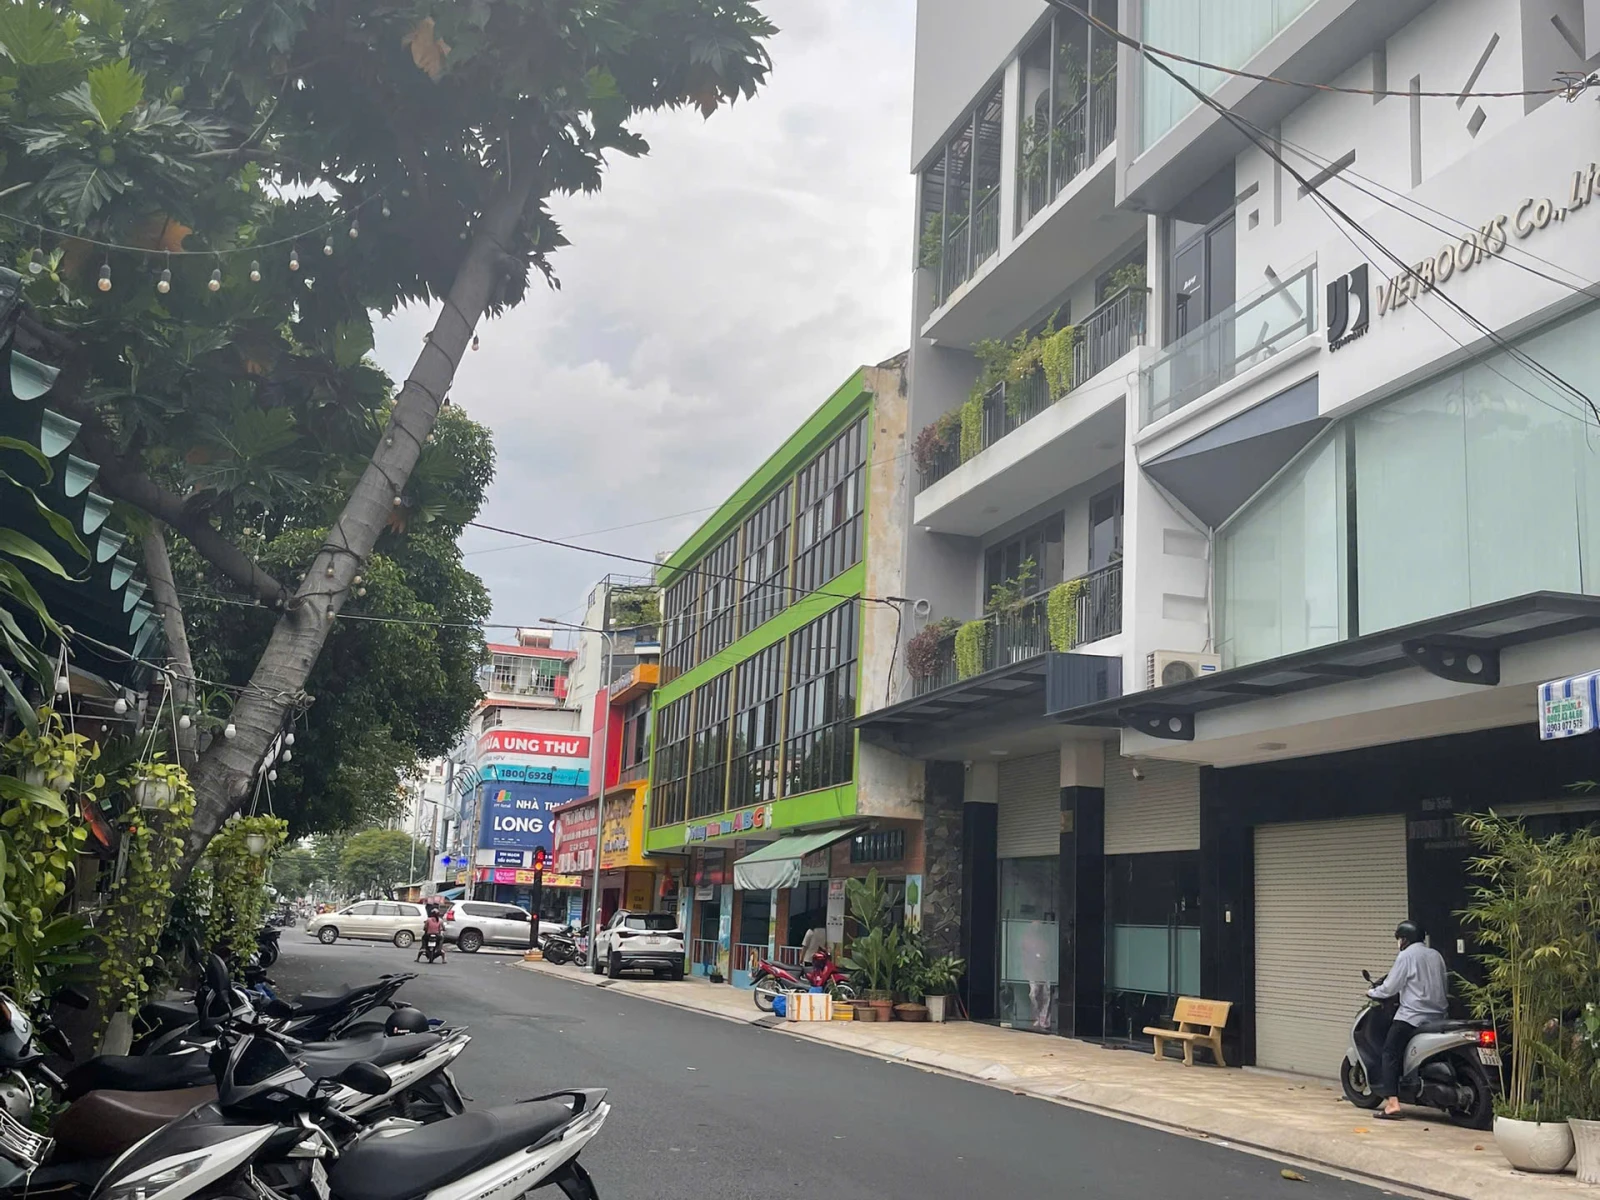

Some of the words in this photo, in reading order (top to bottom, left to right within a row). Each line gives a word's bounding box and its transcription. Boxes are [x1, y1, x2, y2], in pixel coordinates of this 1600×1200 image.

[1376, 215, 1507, 317] VIETBOOKS
[1328, 324, 1370, 354] COMPANY
[503, 737, 539, 752] UNG
[543, 740, 580, 755] THƯ
[501, 769, 525, 779] 1800
[528, 771, 553, 781] 6928
[515, 797, 540, 811] NHÀ
[493, 815, 544, 834] LONG
[732, 805, 766, 833] ABC
